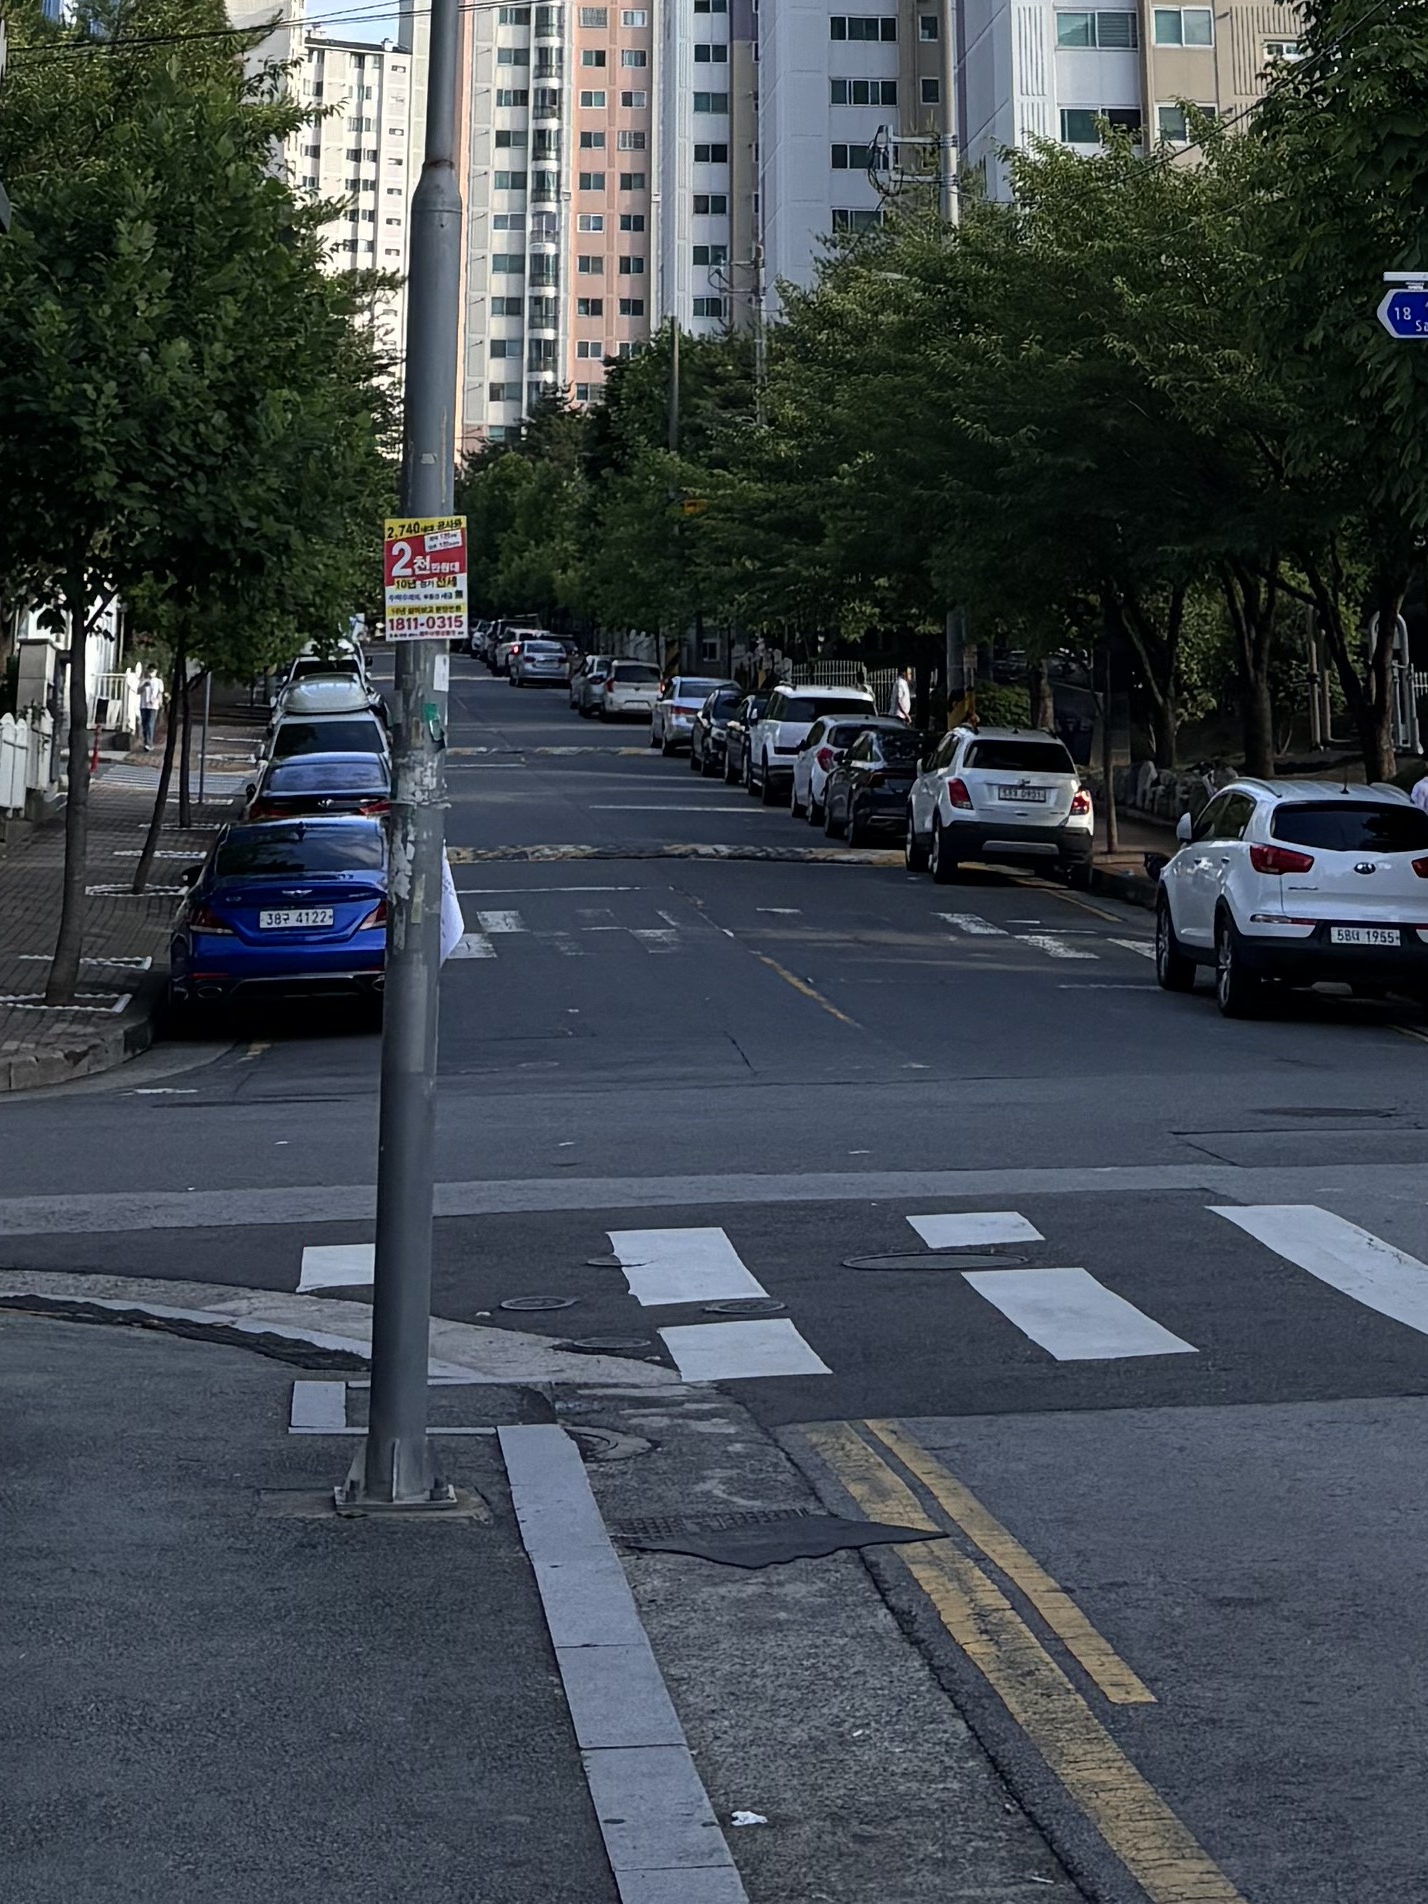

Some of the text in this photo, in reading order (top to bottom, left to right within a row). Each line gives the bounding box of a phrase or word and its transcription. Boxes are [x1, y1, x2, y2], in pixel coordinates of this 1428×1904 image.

[1394, 306, 1412, 321] 18
[388, 614, 464, 631] 1811-0315
[295, 910, 327, 924] 4122
